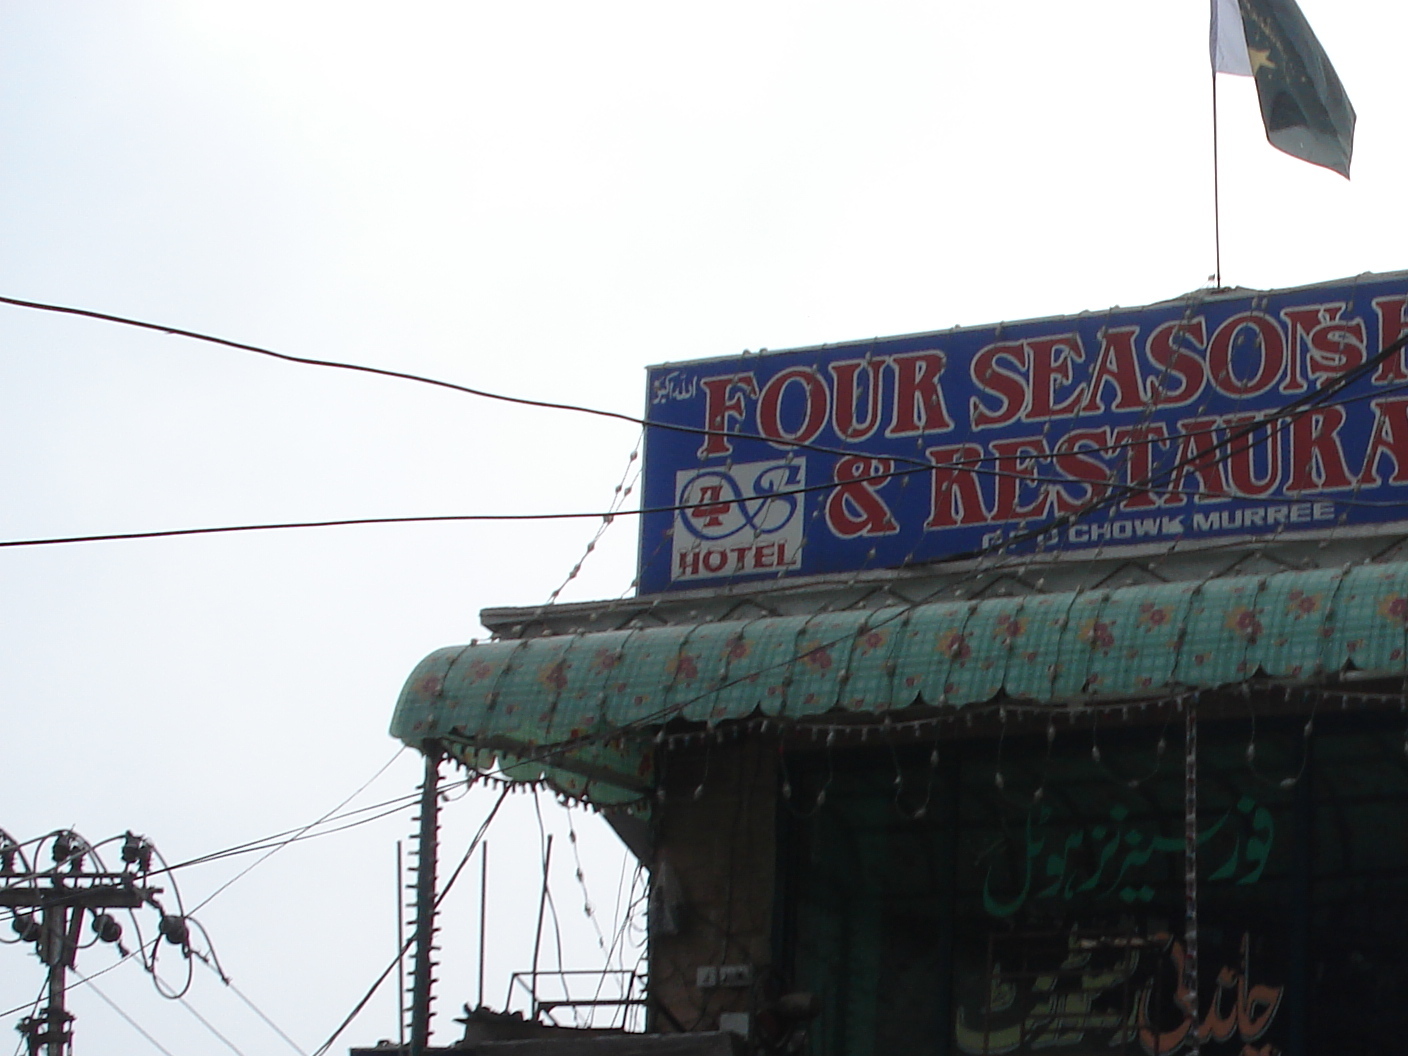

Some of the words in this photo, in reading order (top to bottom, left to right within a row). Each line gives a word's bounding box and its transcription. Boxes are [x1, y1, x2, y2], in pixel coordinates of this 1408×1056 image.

[697, 350, 955, 460] FOUR
[971, 302, 1369, 430] SEASONS
[825, 453, 900, 540] &
[1067, 514, 1186, 543] CHOWK
[1192, 501, 1336, 532] MURREE
[678, 537, 798, 577] HOTEL
